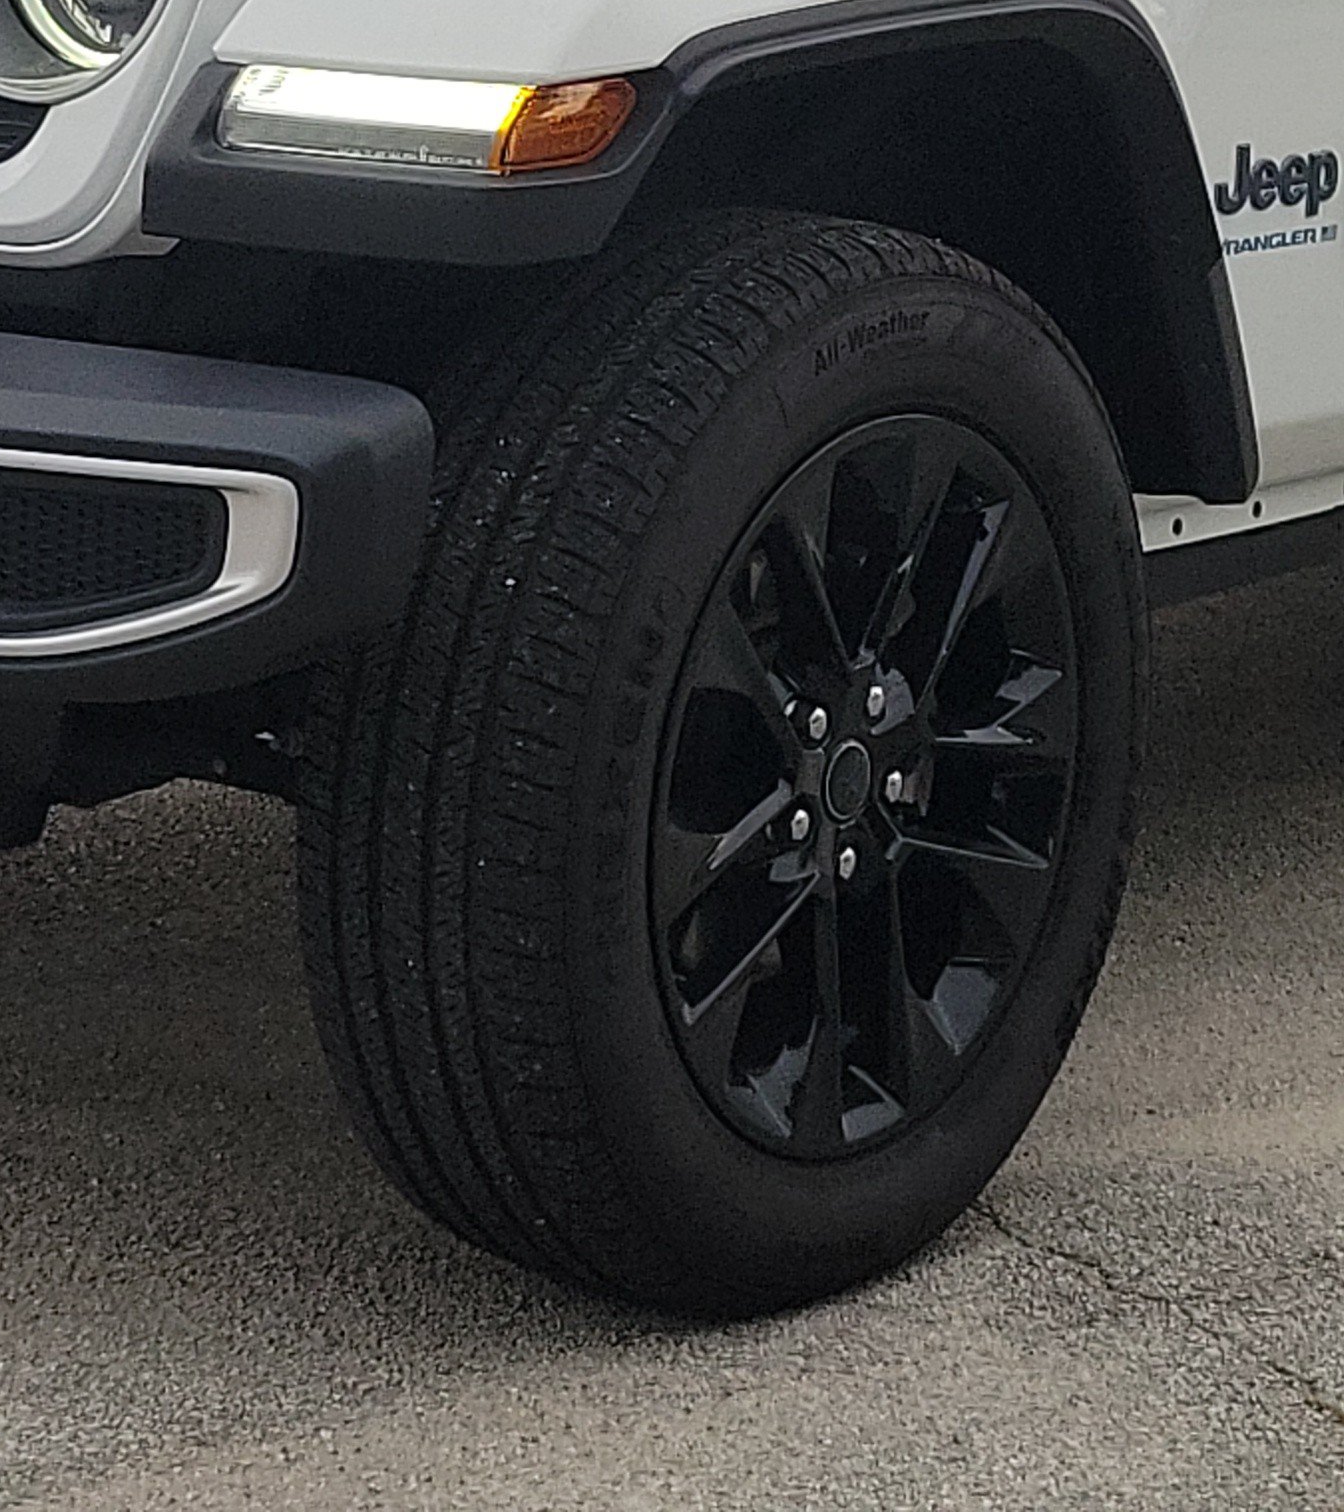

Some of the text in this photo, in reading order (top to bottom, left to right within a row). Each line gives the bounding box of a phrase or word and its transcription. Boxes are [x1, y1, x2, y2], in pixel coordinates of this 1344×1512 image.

[1214, 142, 1339, 218] Jeep
[1223, 227, 1318, 256] RANGLER
[812, 308, 932, 377] All-Weather
